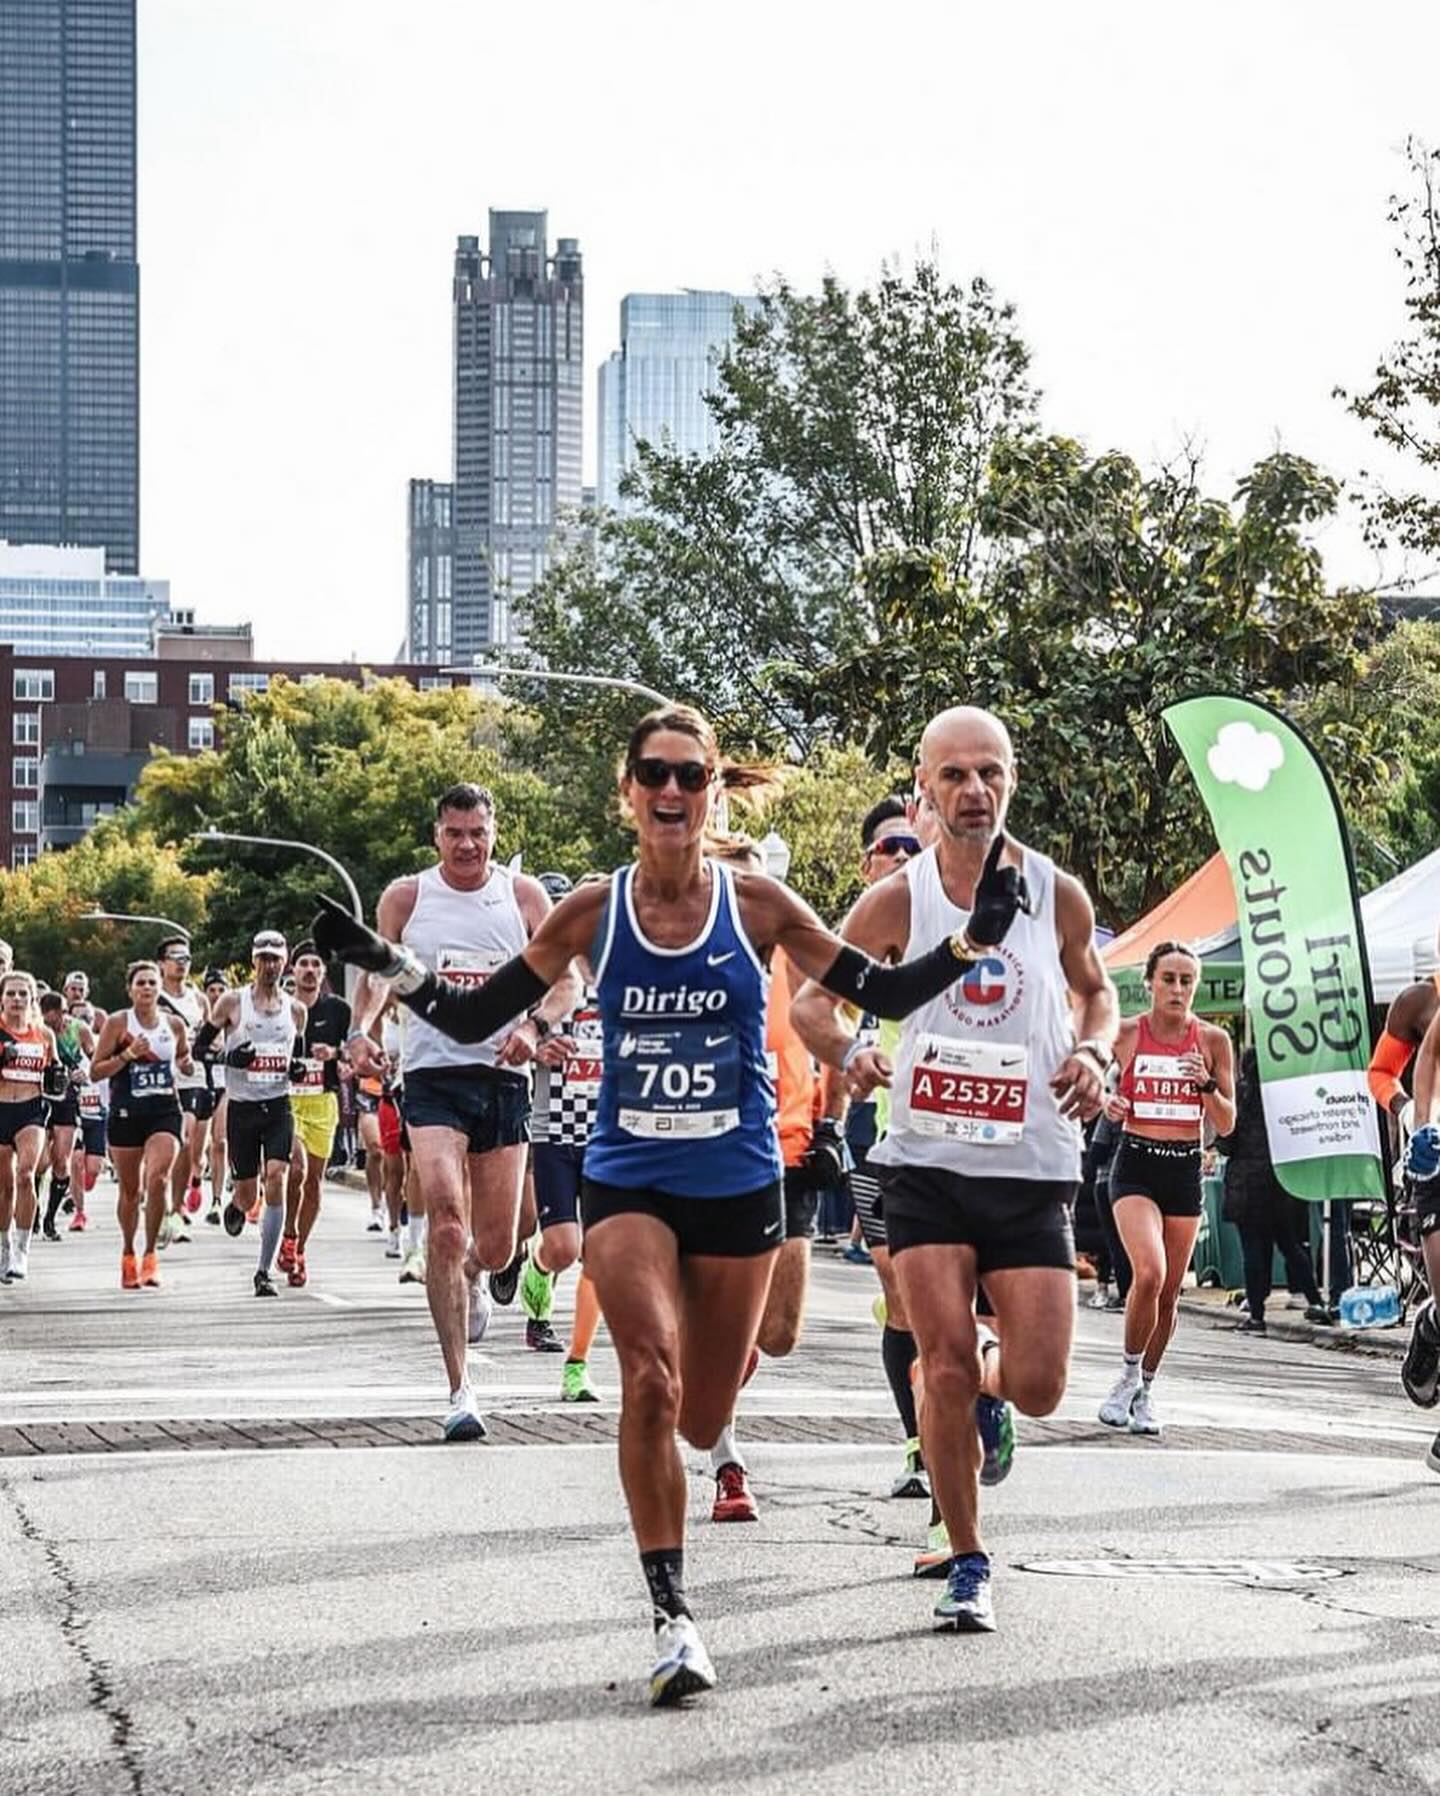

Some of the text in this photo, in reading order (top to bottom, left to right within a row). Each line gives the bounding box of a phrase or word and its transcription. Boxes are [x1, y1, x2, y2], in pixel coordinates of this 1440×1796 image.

[621, 985, 727, 1017] Dirigo
[138, 1072, 166, 1086] 518
[636, 1063, 716, 1098] 705
[915, 1074, 1022, 1108] A 25375
[1135, 1080, 1147, 1094] A
